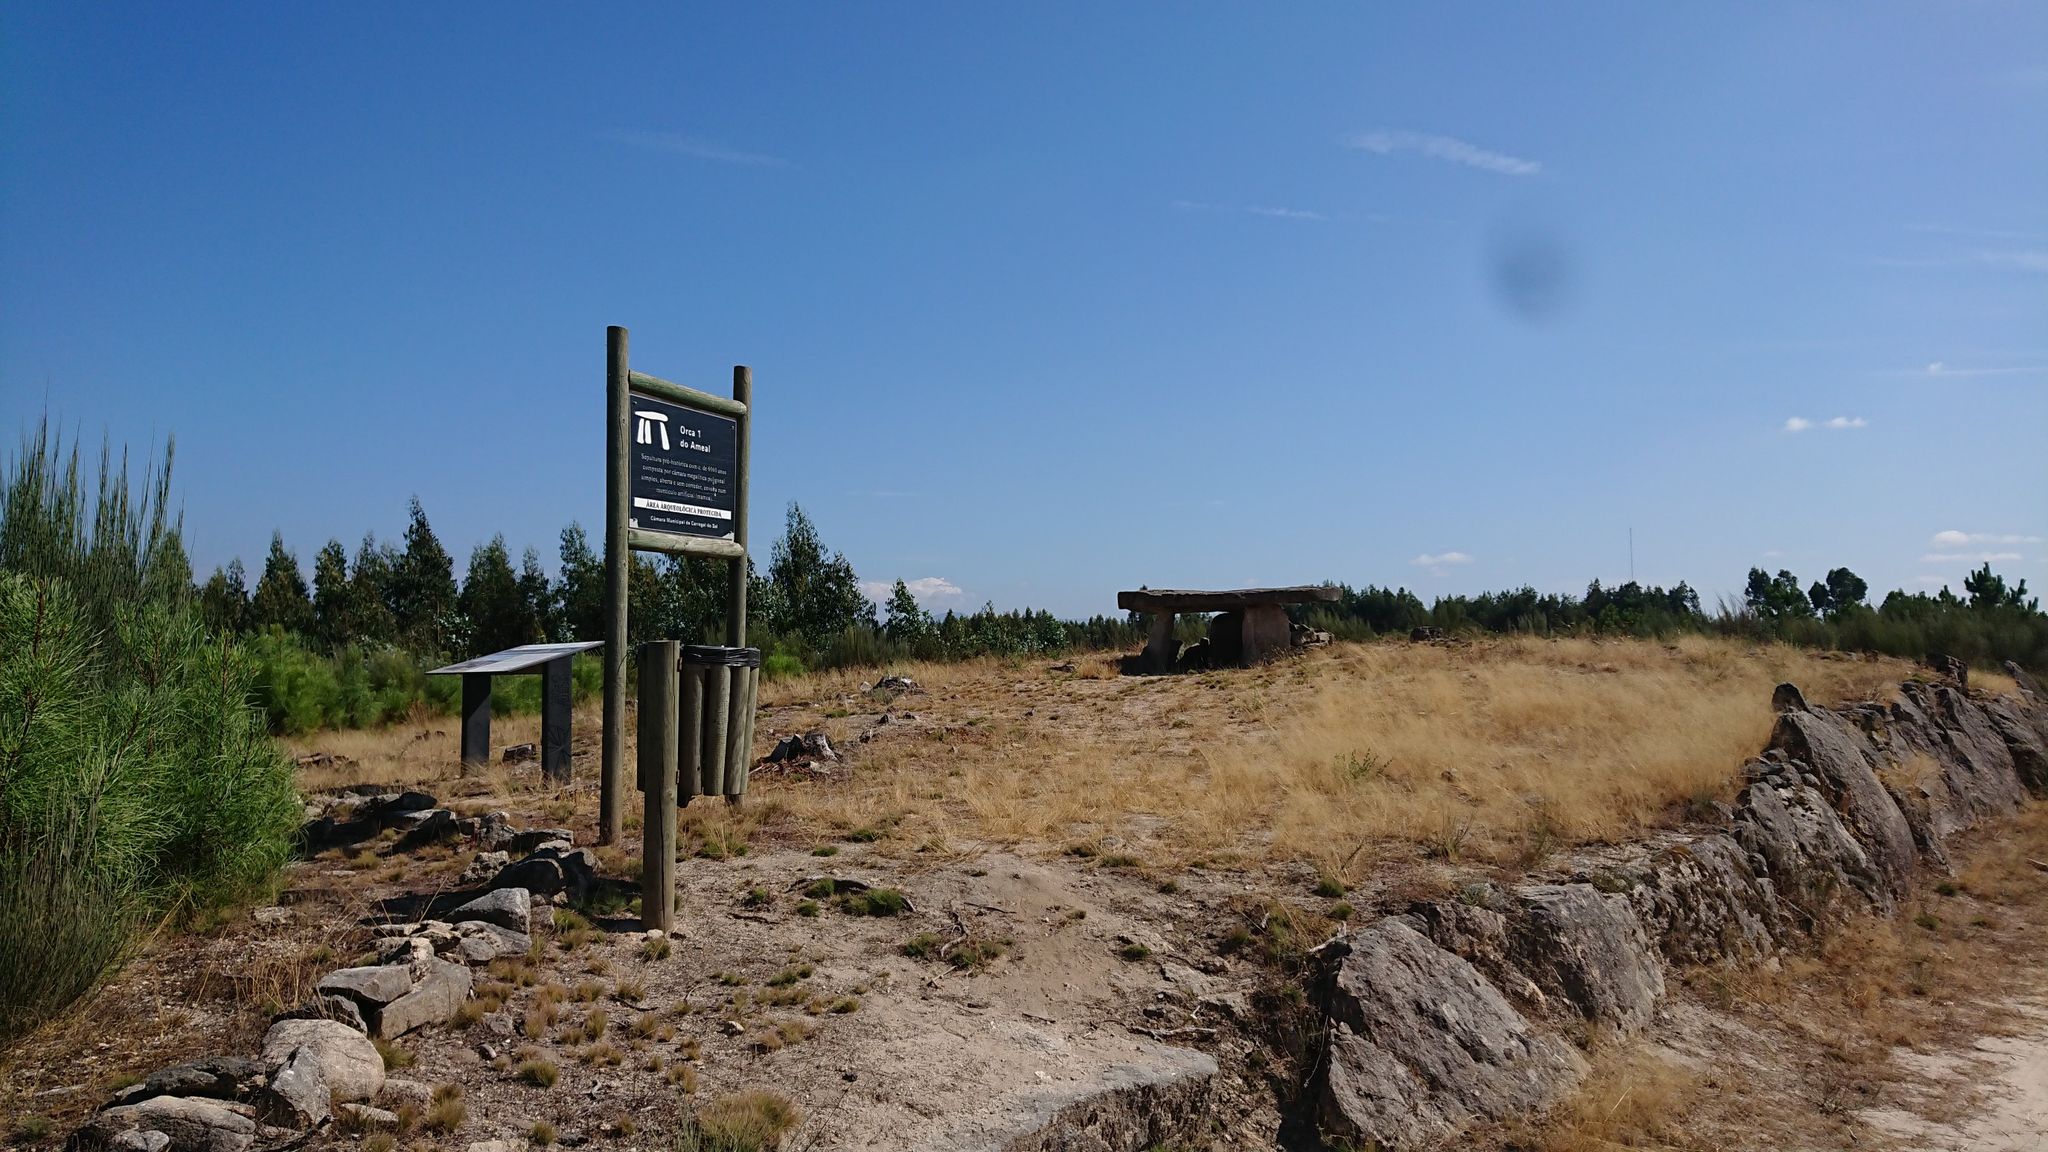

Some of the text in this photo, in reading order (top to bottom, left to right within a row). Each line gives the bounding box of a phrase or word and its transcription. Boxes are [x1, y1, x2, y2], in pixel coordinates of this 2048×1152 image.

[680, 426, 701, 438] Orca 1
[680, 439, 710, 452] do Ameal
[646, 500, 722, 517] ÁREA ARQUEOLÓGICA PROTECIDA
